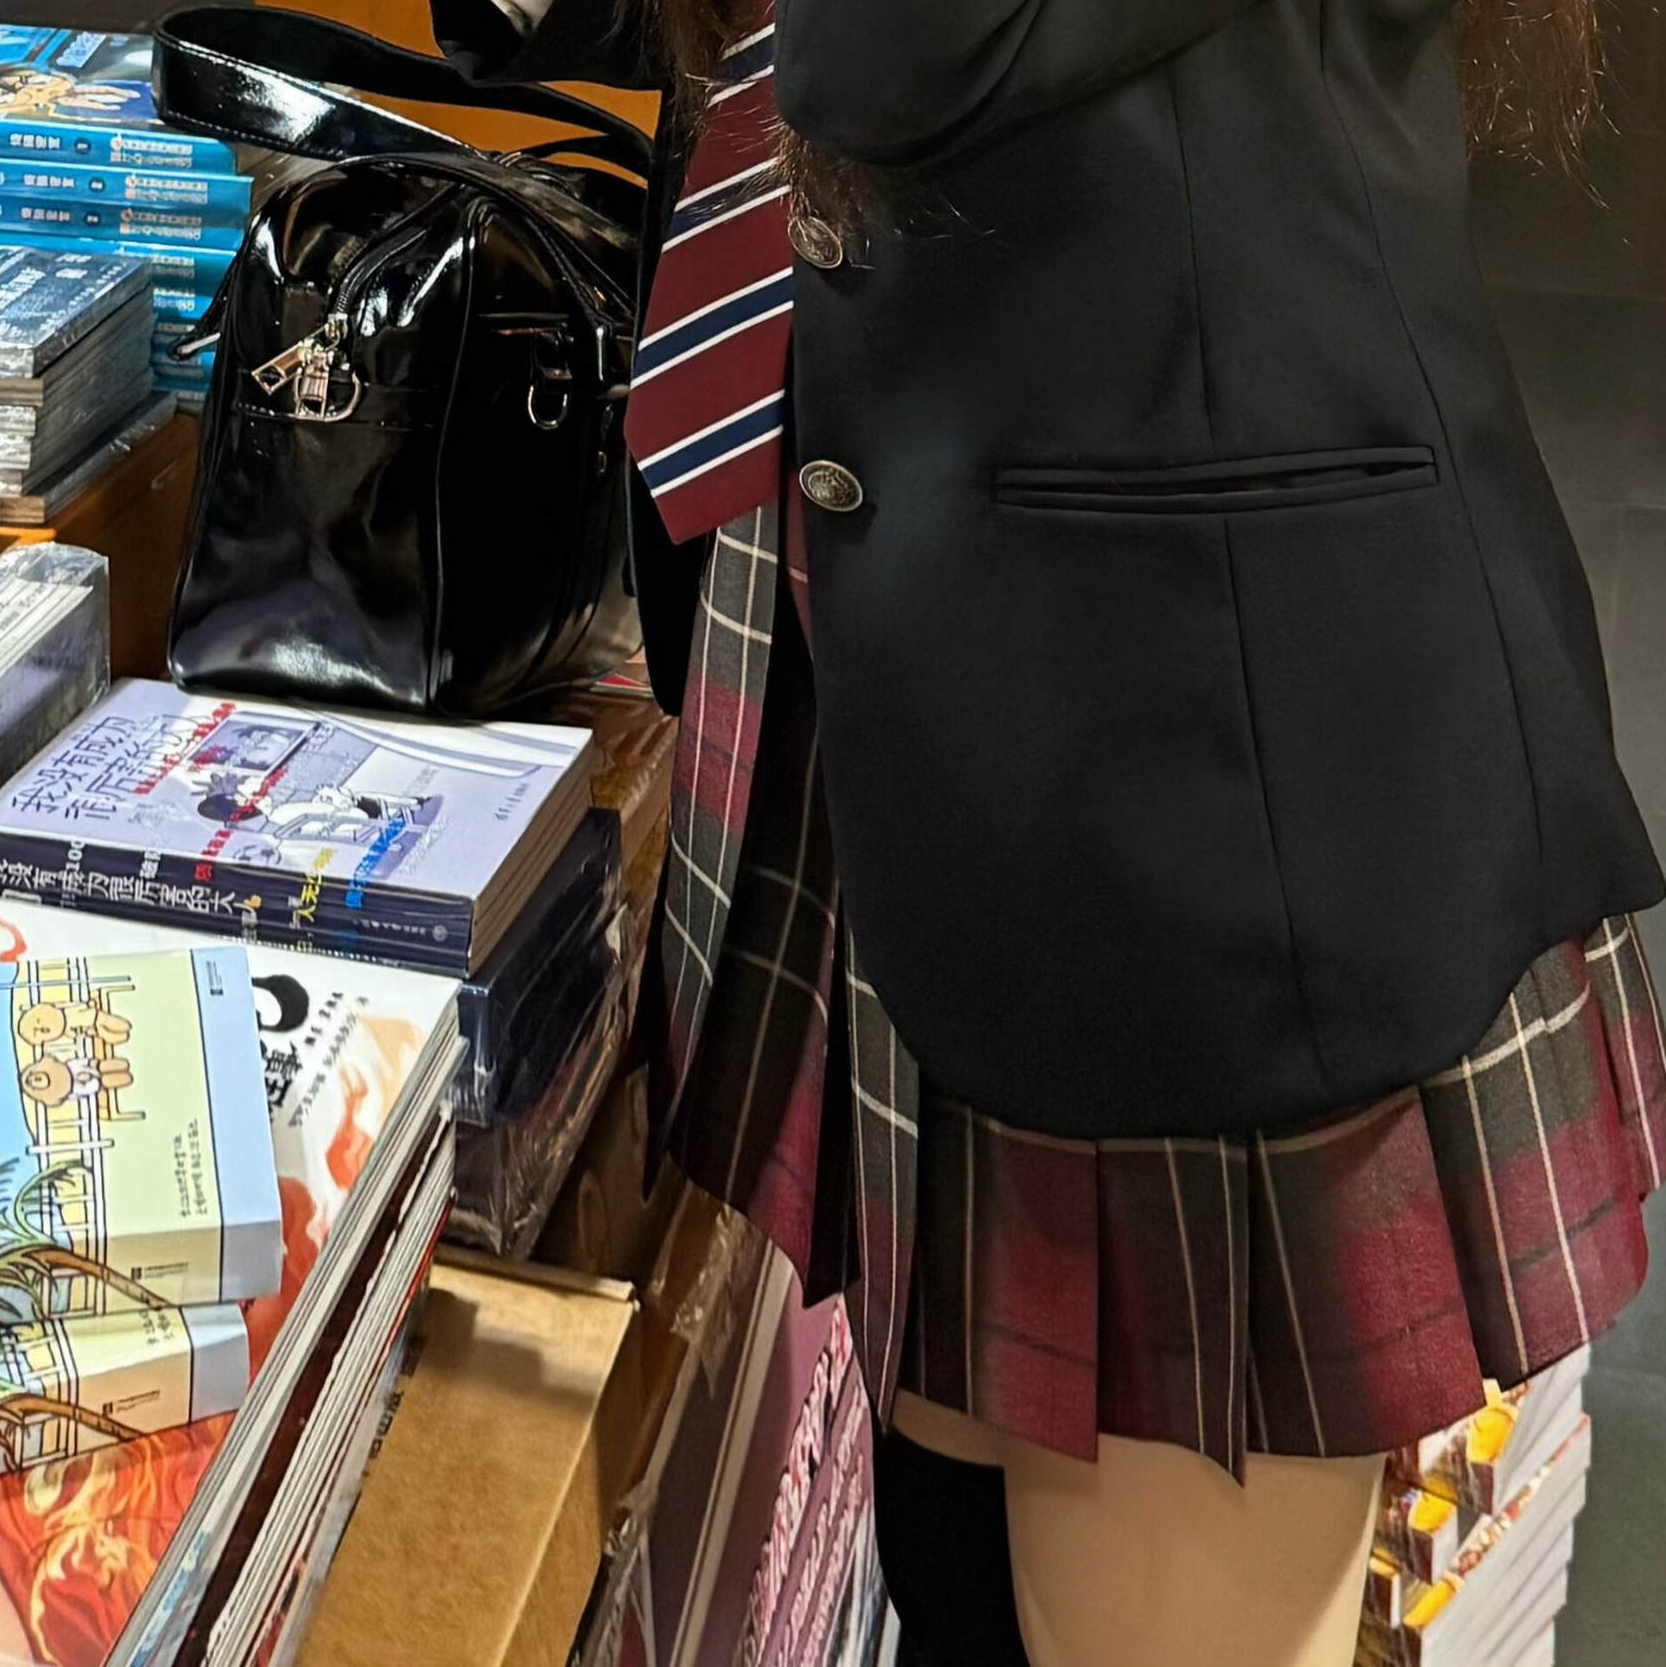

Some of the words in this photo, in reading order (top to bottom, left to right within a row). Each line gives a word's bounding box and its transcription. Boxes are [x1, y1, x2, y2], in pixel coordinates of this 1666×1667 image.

[12, 714, 145, 816] 我没有成为
